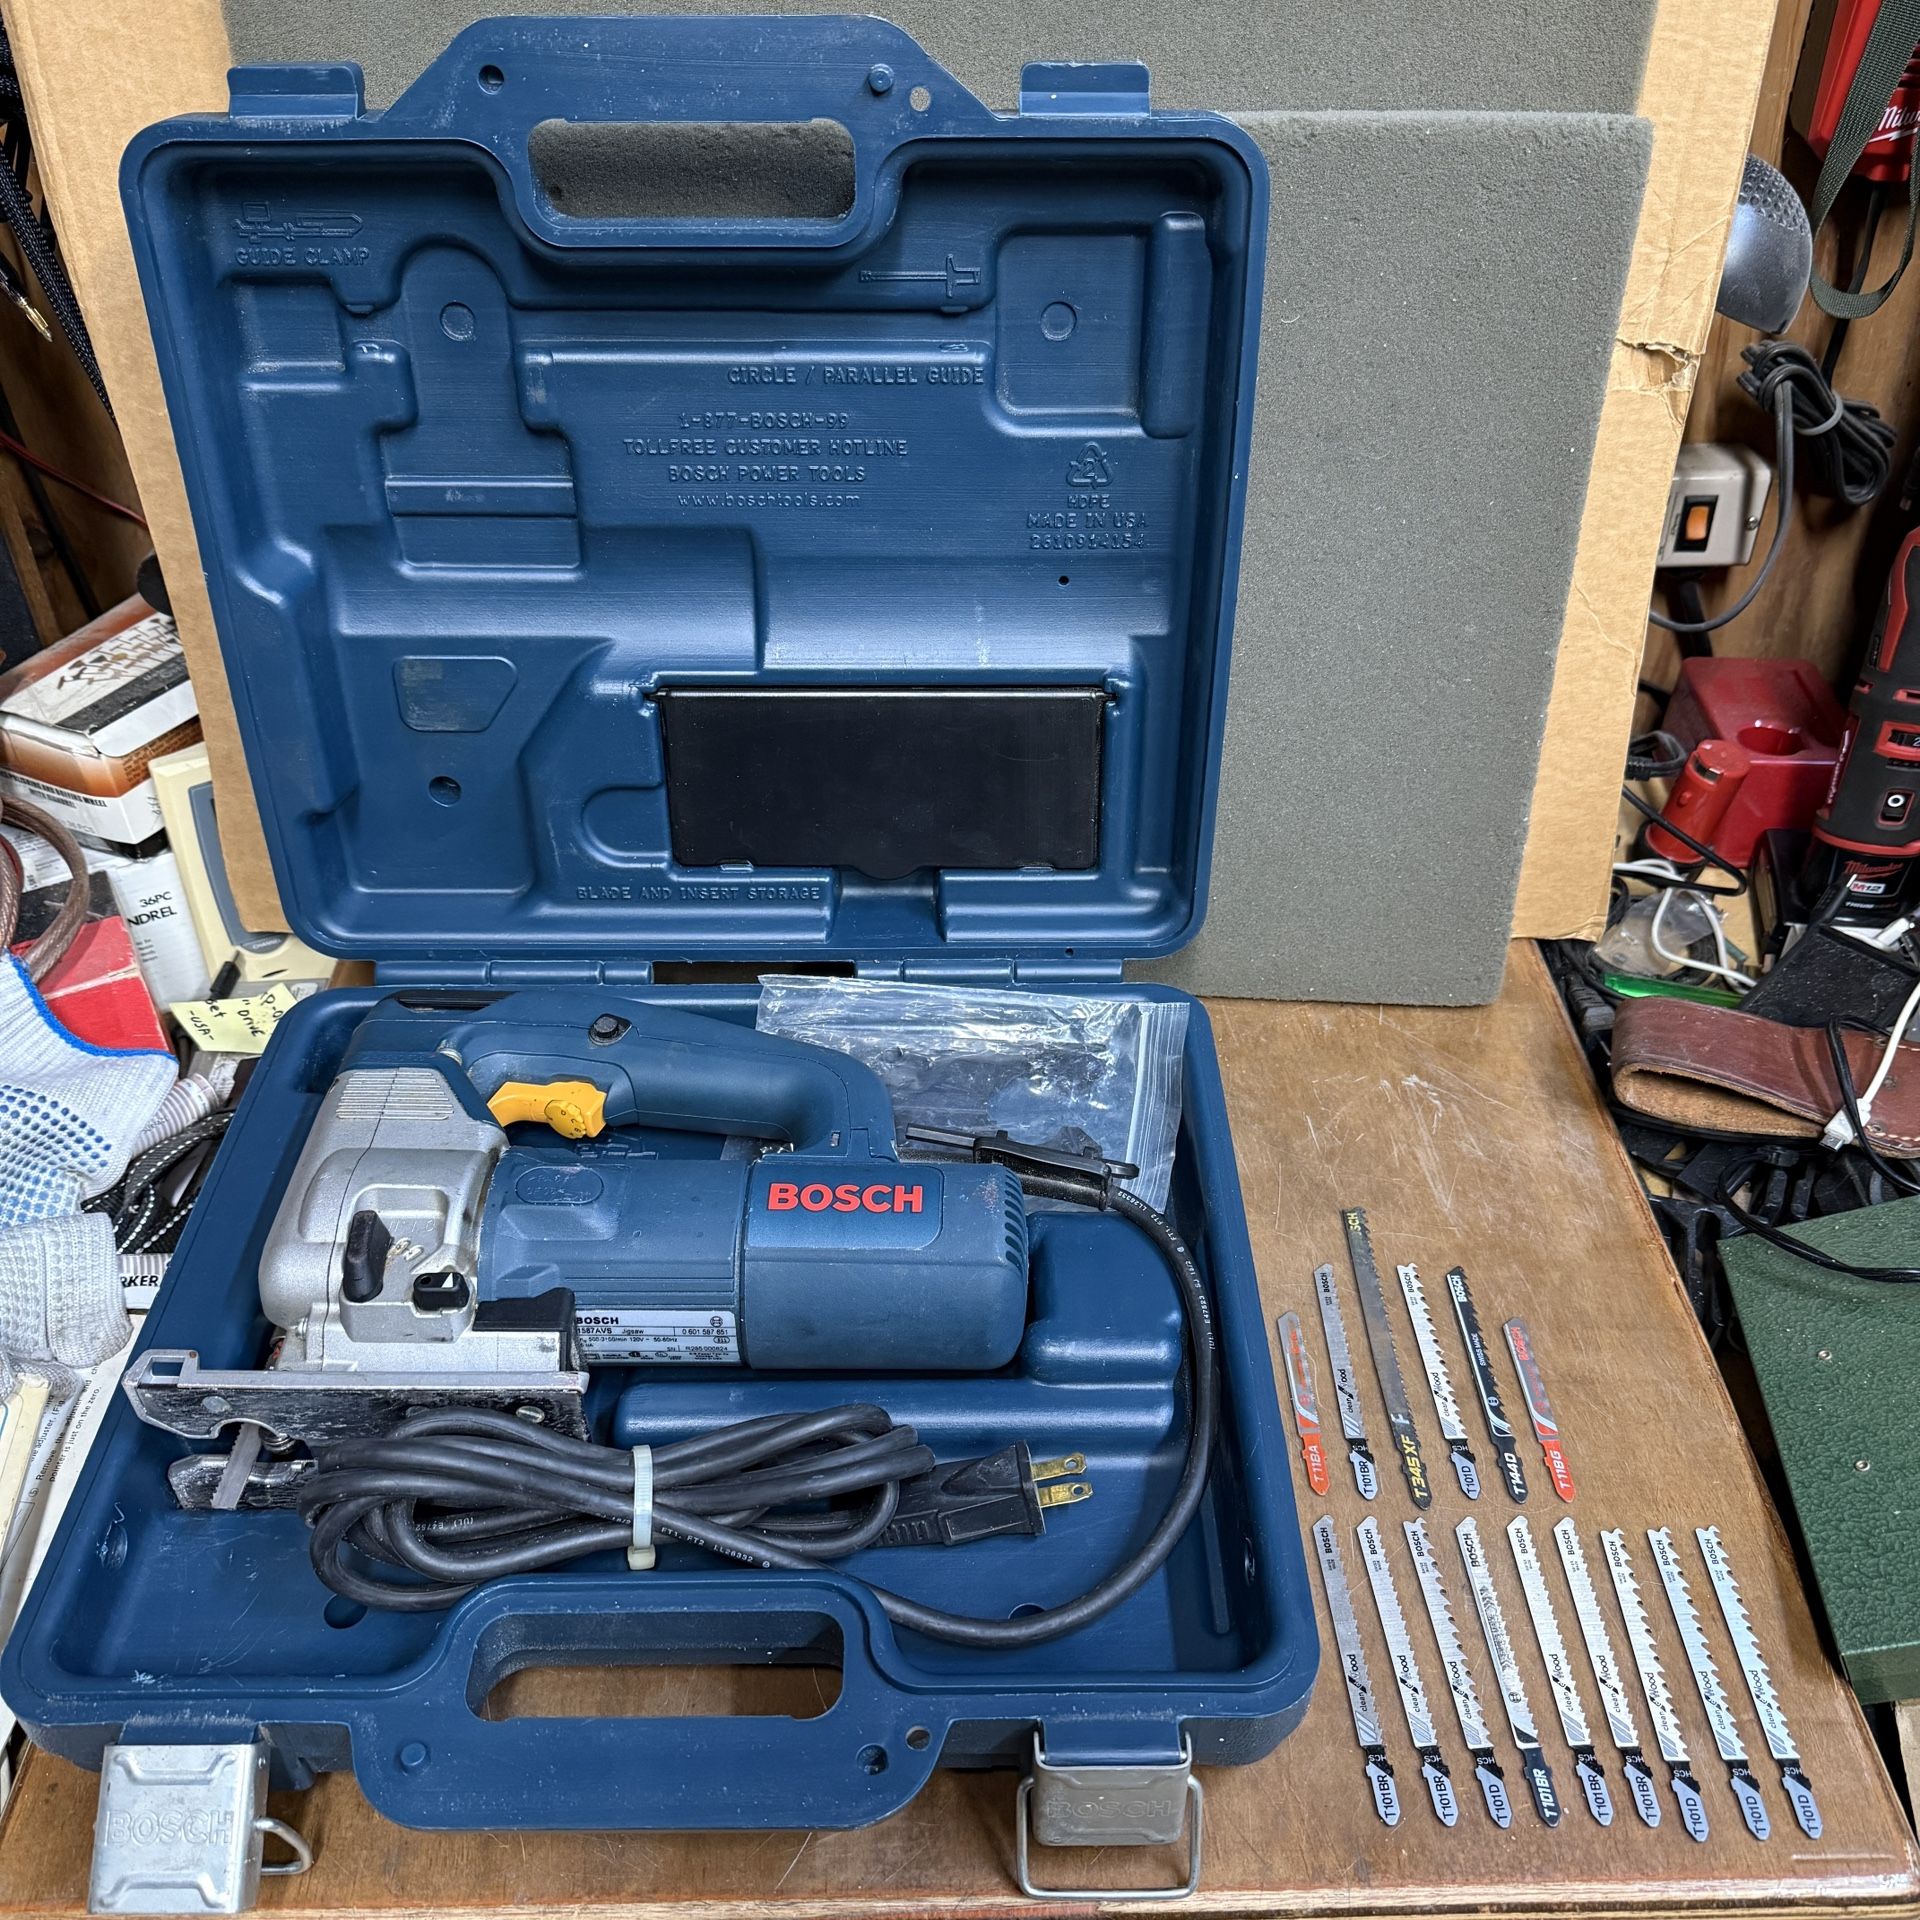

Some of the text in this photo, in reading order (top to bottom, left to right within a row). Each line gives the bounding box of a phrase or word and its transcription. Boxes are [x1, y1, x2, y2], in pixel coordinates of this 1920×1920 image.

[236, 247, 370, 266] GUIDE CLAMP
[728, 366, 985, 385] CIRCLE / PARALLEL GUIDE
[679, 411, 850, 430] 1-877-BOSCH-99
[623, 439, 907, 456] TOLLFREE CUSTOMER HOTLINE
[668, 465, 866, 482] BOSCH POWER TOOLS
[678, 491, 861, 508] www.boschtools.com
[1067, 494, 1110, 509] HDPE
[1027, 512, 1149, 528] MADE IN USA
[139, 891, 173, 908] 36PC
[577, 886, 821, 900] BLADE AND INSERT STORAGE
[126, 906, 178, 928] NDREL
[768, 1182, 923, 1214] BOSCH
[1347, 1212, 1362, 1235] SCH
[120, 1275, 159, 1288] RKER
[1320, 1272, 1331, 1293] BOSCH
[1403, 1272, 1415, 1293] BOSCH
[1451, 1275, 1468, 1303] BOSCH
[576, 1316, 619, 1325] BOSCH
[577, 1327, 612, 1335] 1587AVS
[35, 1449, 57, 1480] Remove
[55, 1431, 65, 1444] the
[49, 1454, 67, 1482] pointer
[69, 1429, 79, 1445] just
[75, 1419, 85, 1430] on
[81, 1405, 91, 1420] the
[1308, 1445, 1324, 1482] T118A
[1400, 1434, 1428, 1499] T345XF
[1504, 1452, 1526, 1495] T144D
[1549, 1449, 1571, 1489] T118G
[1358, 1460, 1374, 1494] T101BR
[1461, 1465, 1477, 1494] T101D
[687, 1535, 705, 1546] FT2
[1320, 1527, 1333, 1554] BOSCH
[1364, 1528, 1378, 1555] BOSCH
[1410, 1530, 1425, 1557] BOSCH
[1462, 1532, 1481, 1568] BOSCH
[1514, 1527, 1529, 1554] BOSCH
[1561, 1529, 1576, 1556] BOSCH
[1656, 1539, 1671, 1566] BOSCH
[1704, 1538, 1720, 1565] BOSCH
[1608, 1541, 1622, 1567] BOSCH
[1698, 1671, 1715, 1697] Wood
[1748, 1669, 1766, 1695] Wood
[1368, 1754, 1387, 1762] HCS
[1423, 1755, 1442, 1763] HCS
[1476, 1757, 1495, 1765] HCS
[1577, 1753, 1597, 1762] HCS
[1625, 1755, 1644, 1763] HCS
[1783, 1766, 1803, 1775] HCS
[1673, 1769, 1692, 1778] HCS
[1732, 1767, 1752, 1776] HCS
[1377, 1774, 1397, 1819] T101BR
[1433, 1775, 1455, 1820] T101BR
[1488, 1783, 1509, 1822] T101D
[1532, 1768, 1558, 1818] T101BR
[1588, 1774, 1610, 1820] T101BR
[1635, 1775, 1658, 1820] T101BR
[1046, 1800, 1172, 1818] BOSCH
[1685, 1797, 1705, 1835] T101D
[1745, 1795, 1767, 1834] T101D
[1797, 1794, 1819, 1833] T101D
[104, 1809, 236, 1847] BOSCH
